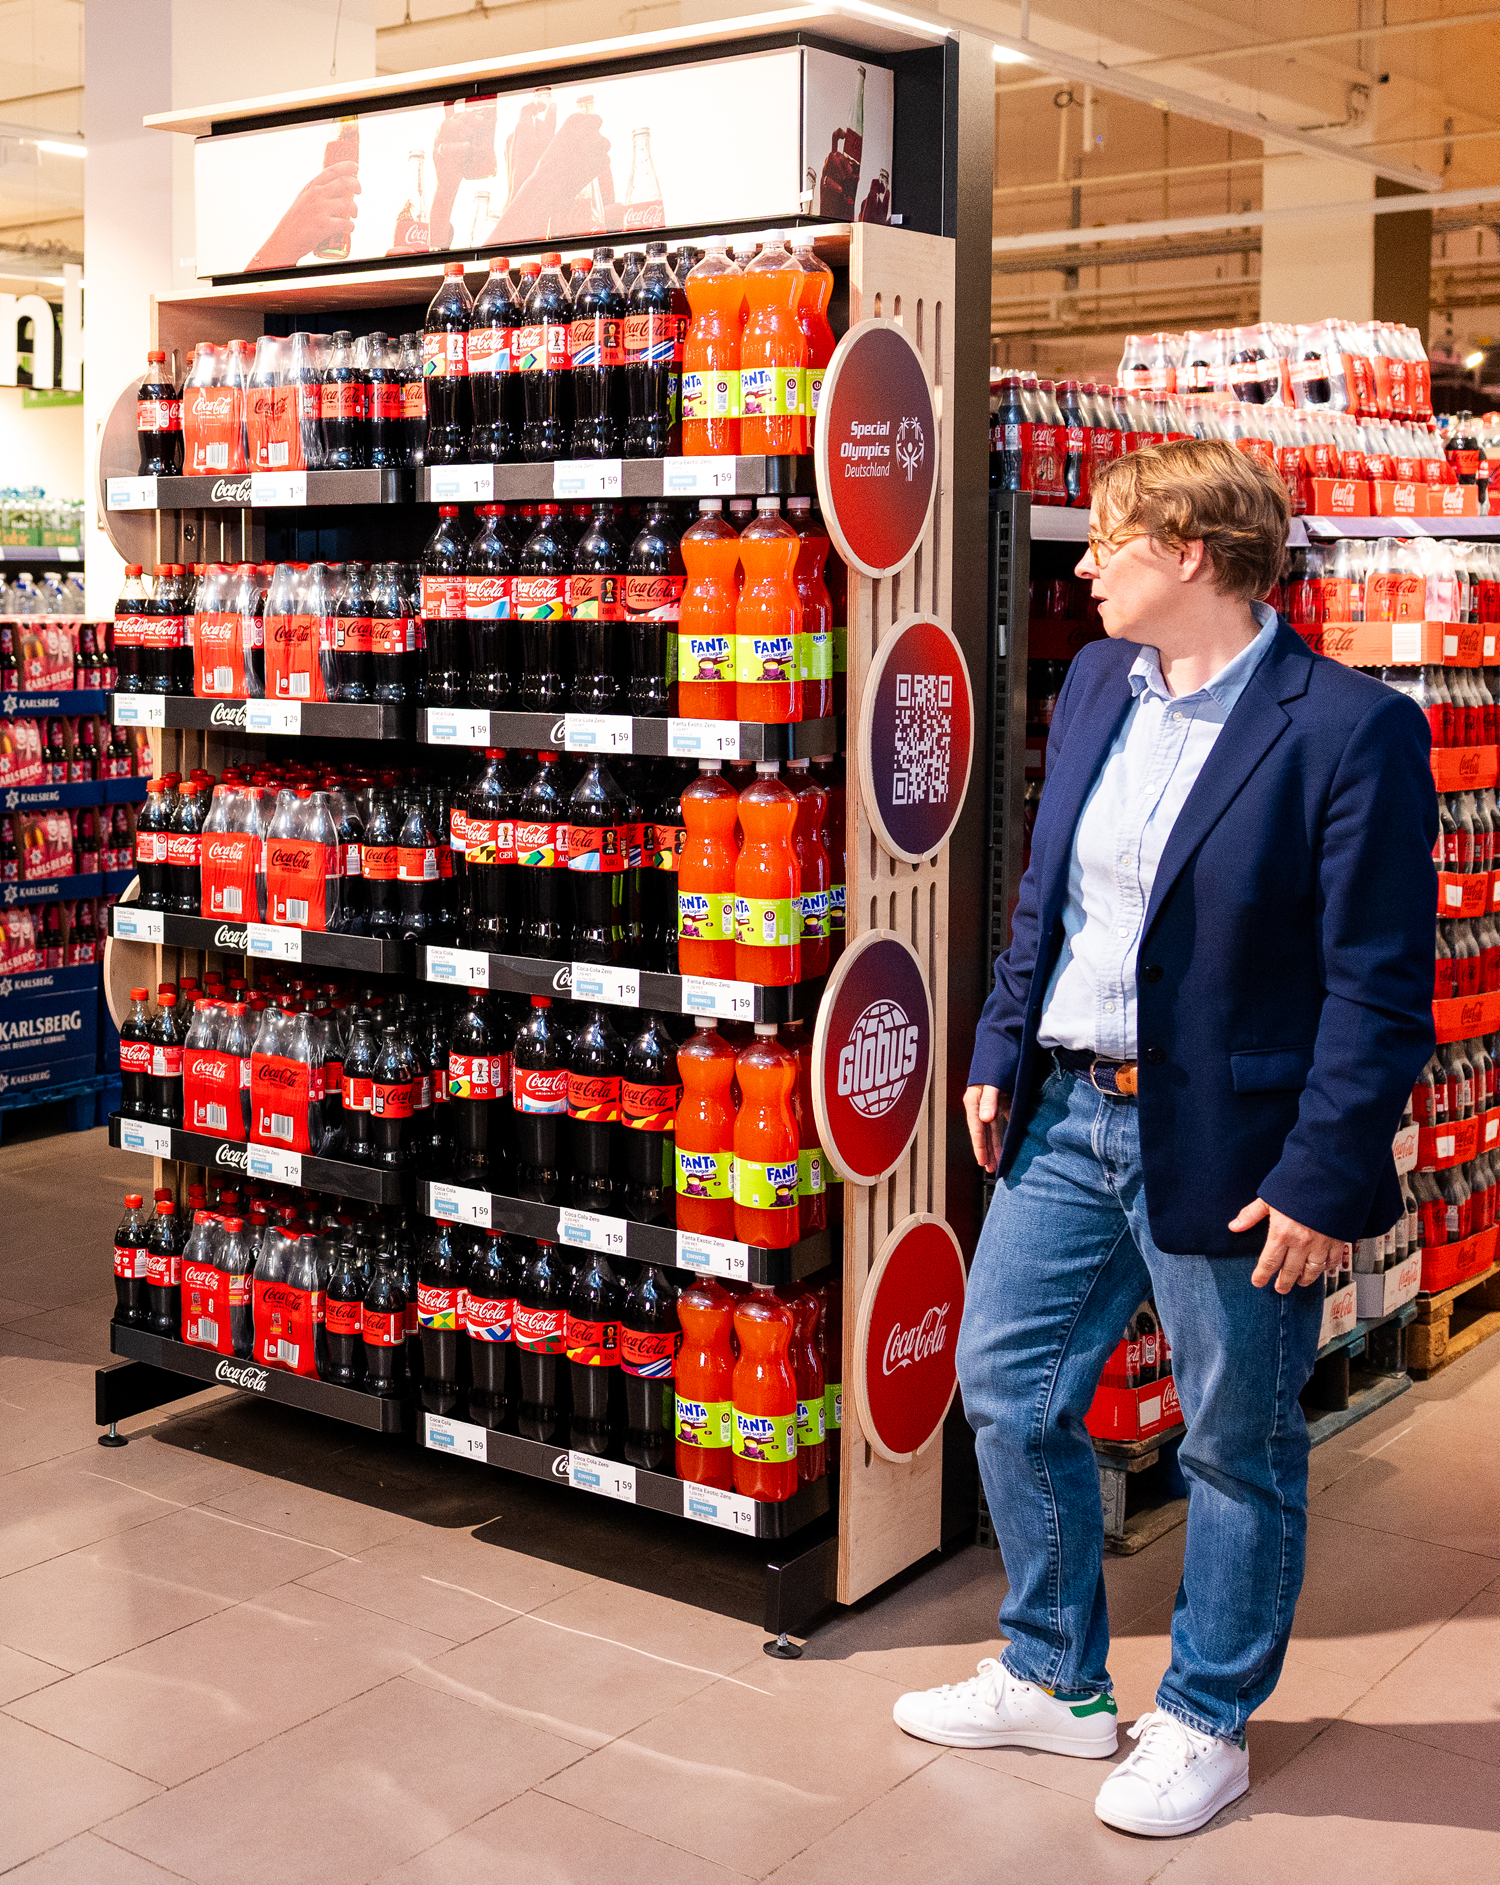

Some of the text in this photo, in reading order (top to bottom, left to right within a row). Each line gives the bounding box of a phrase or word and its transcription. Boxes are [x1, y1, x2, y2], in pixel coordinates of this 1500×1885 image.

[624, 204, 663, 225] Coca-Cola
[850, 421, 890, 439] Special
[840, 442, 890, 460] Olympics
[845, 462, 890, 477] Deutschland
[1332, 482, 1355, 507] Coca-Cola
[1394, 484, 1415, 508] Coca-Cola
[1443, 486, 1464, 510] Coca-Cola
[628, 578, 681, 598] Coca-Cola
[1374, 577, 1419, 594] Coca-Cola
[691, 638, 730, 654] FANTA
[754, 638, 793, 655] FANTA
[26, 667, 74, 691] KARLSBERG
[20, 698, 59, 709] KARLSBERG
[21, 791, 60, 803] KARLSBERG
[20, 884, 58, 897] KARLSBERG
[679, 895, 708, 909] FANTA
[14, 975, 53, 990] KARLSBERG
[10, 1070, 50, 1085] KARLSBERG
[568, 1077, 615, 1099] Coca-Cola
[623, 1084, 670, 1108] Coca-Cola
[680, 1154, 716, 1169] FANTA
[568, 1229, 587, 1237] EINWEG
[697, 1237, 712, 1245] Exotic
[686, 1252, 705, 1261] EINWEG
[466, 1296, 508, 1320] Coca-Cola
[516, 1306, 559, 1331] Coca-Cola
[622, 1330, 669, 1355] Coca-Cola
[882, 1302, 950, 1376] Coca-Cola
[216, 1359, 270, 1392] Coca-Cola
[677, 1400, 707, 1416] FANTA
[738, 1415, 774, 1432] FANTA
[434, 1434, 450, 1442] EINWEG
[578, 1472, 596, 1482] EINWEG
[689, 1484, 702, 1493] Fanta
[703, 1488, 718, 1497] Exotic
[694, 1503, 712, 1513] EINWEG
